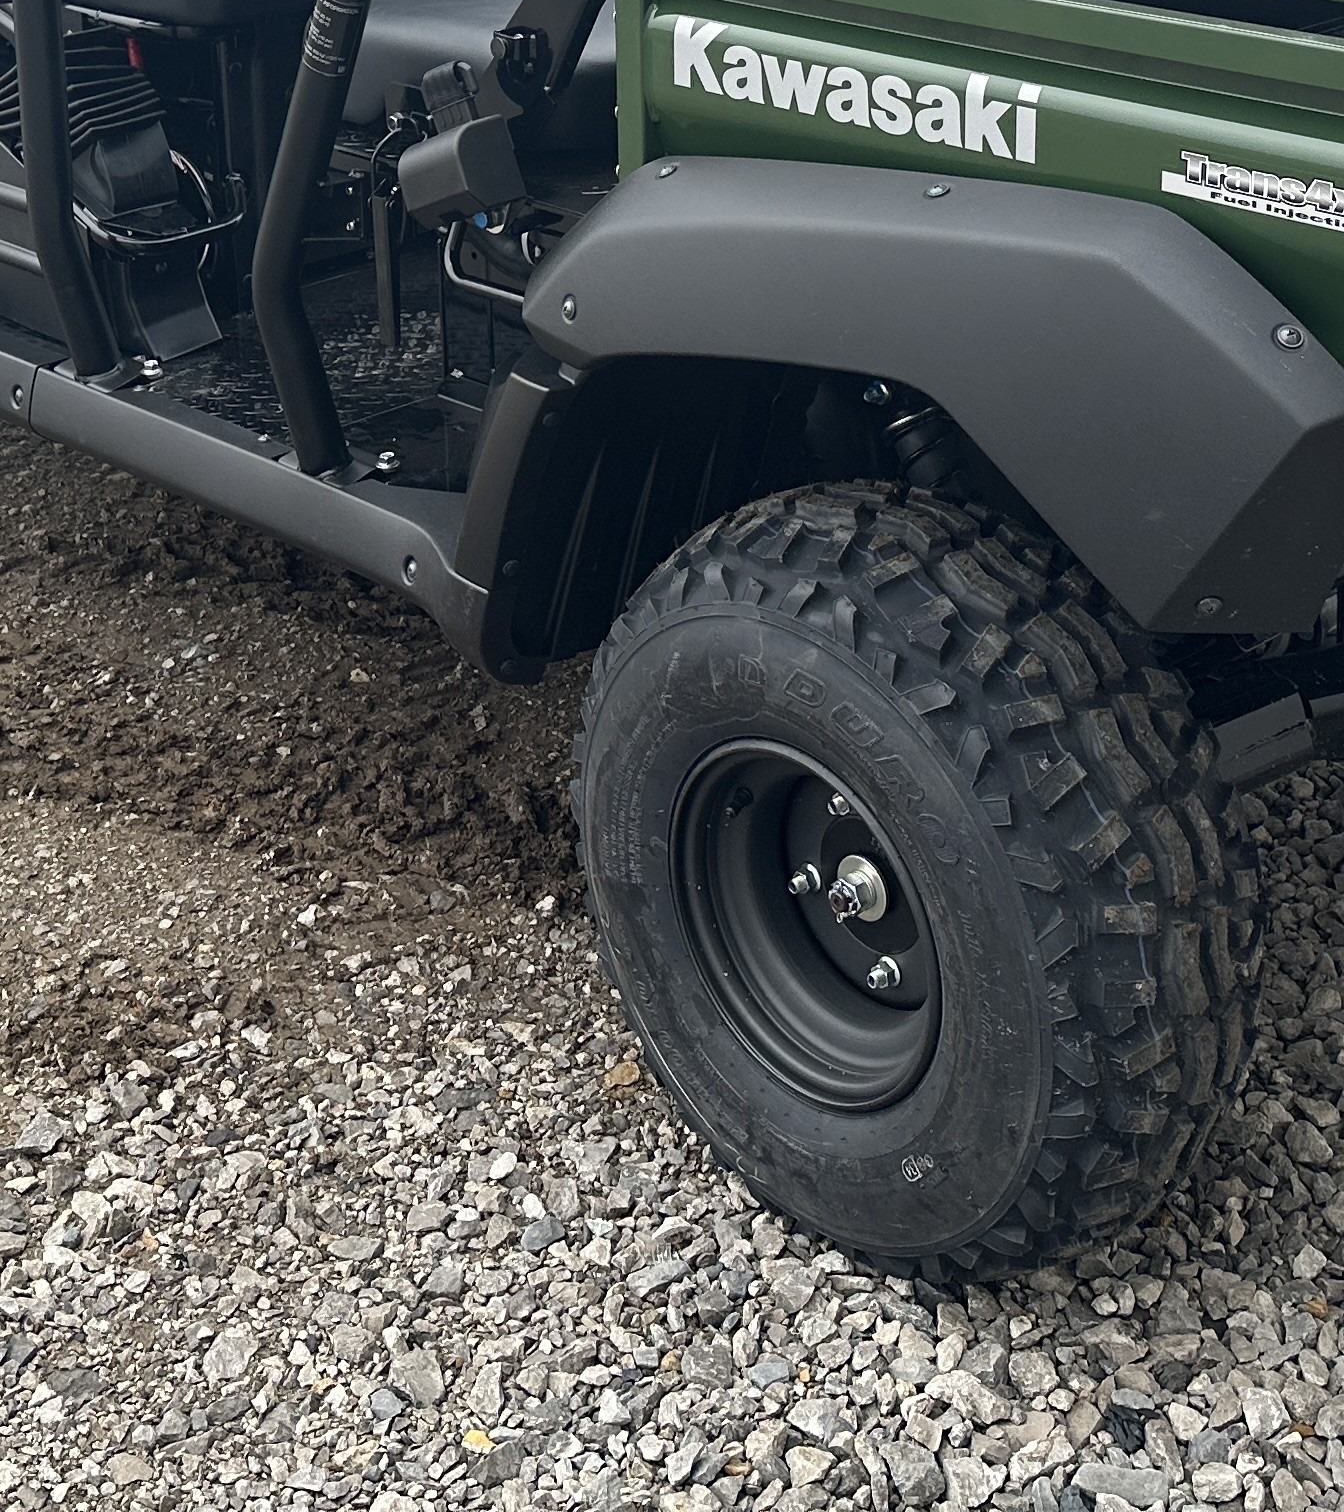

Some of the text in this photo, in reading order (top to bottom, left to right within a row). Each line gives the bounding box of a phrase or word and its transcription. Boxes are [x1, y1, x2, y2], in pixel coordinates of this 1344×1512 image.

[671, 14, 1043, 165] Kawasaki
[1210, 191, 1258, 209] Fuel
[783, 668, 960, 864] DURO
